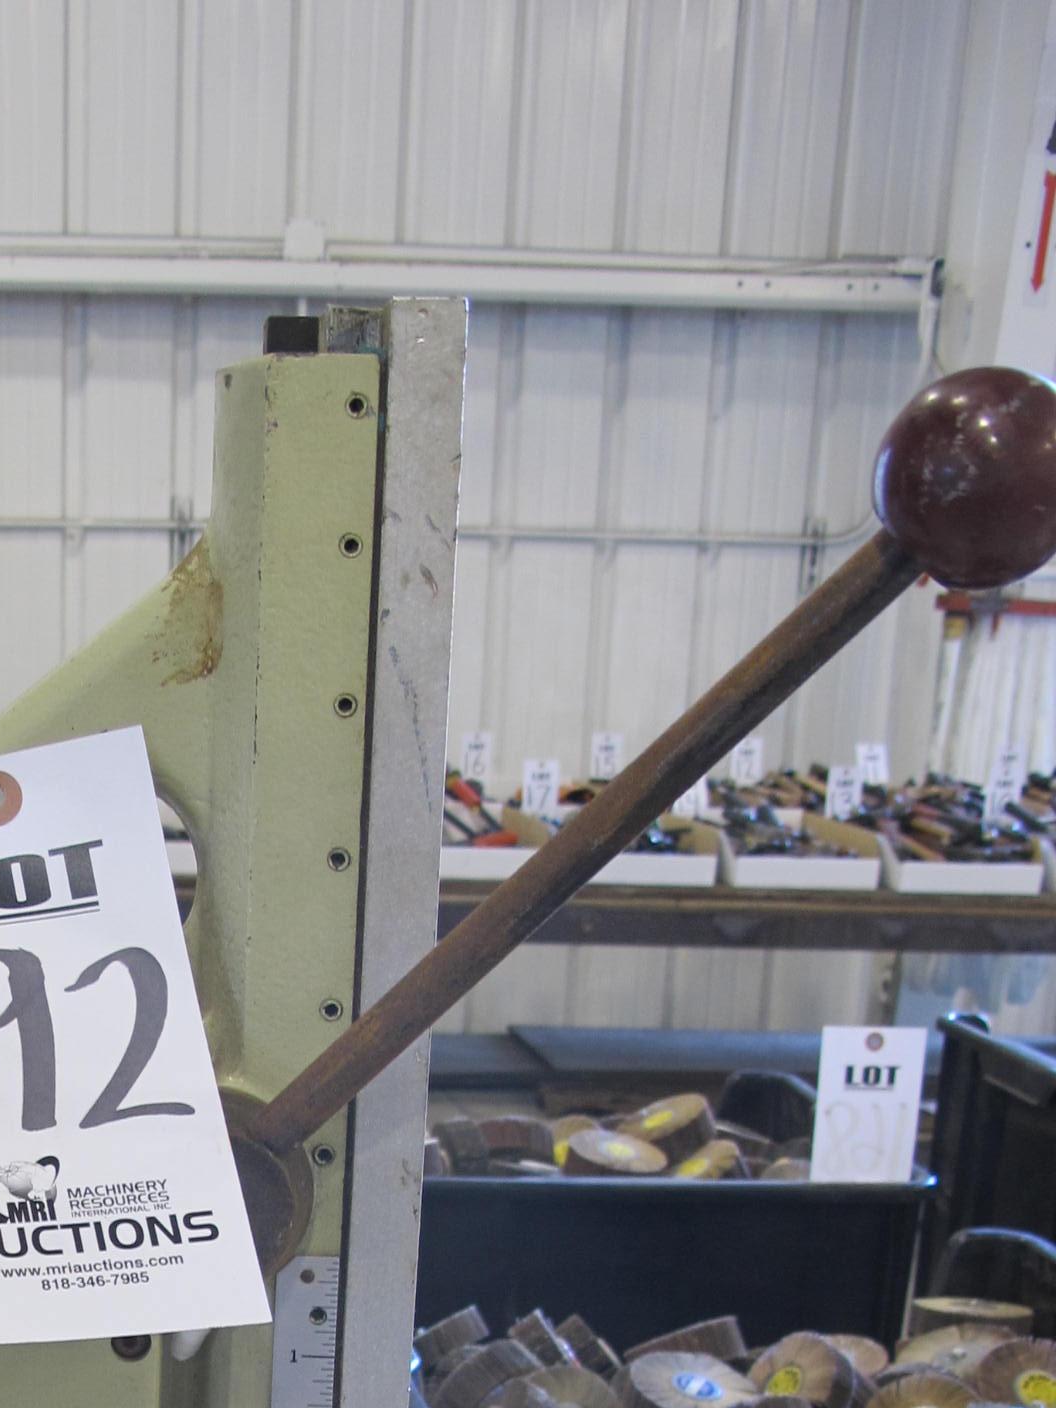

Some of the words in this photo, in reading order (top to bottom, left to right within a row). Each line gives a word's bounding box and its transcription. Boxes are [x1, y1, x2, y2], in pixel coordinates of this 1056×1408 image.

[845, 1065, 900, 1086] LOT
[67, 1179, 168, 1199] MACHINERY
[69, 1190, 170, 1211] RESOURCES
[8, 1199, 57, 1224] MRI
[71, 1205, 150, 1218] INTERNATIONAL
[0, 1254, 184, 1279] www.mriauctions.com
[41, 1271, 150, 1292] 818-346-7985
[289, 1349, 298, 1363] 1
